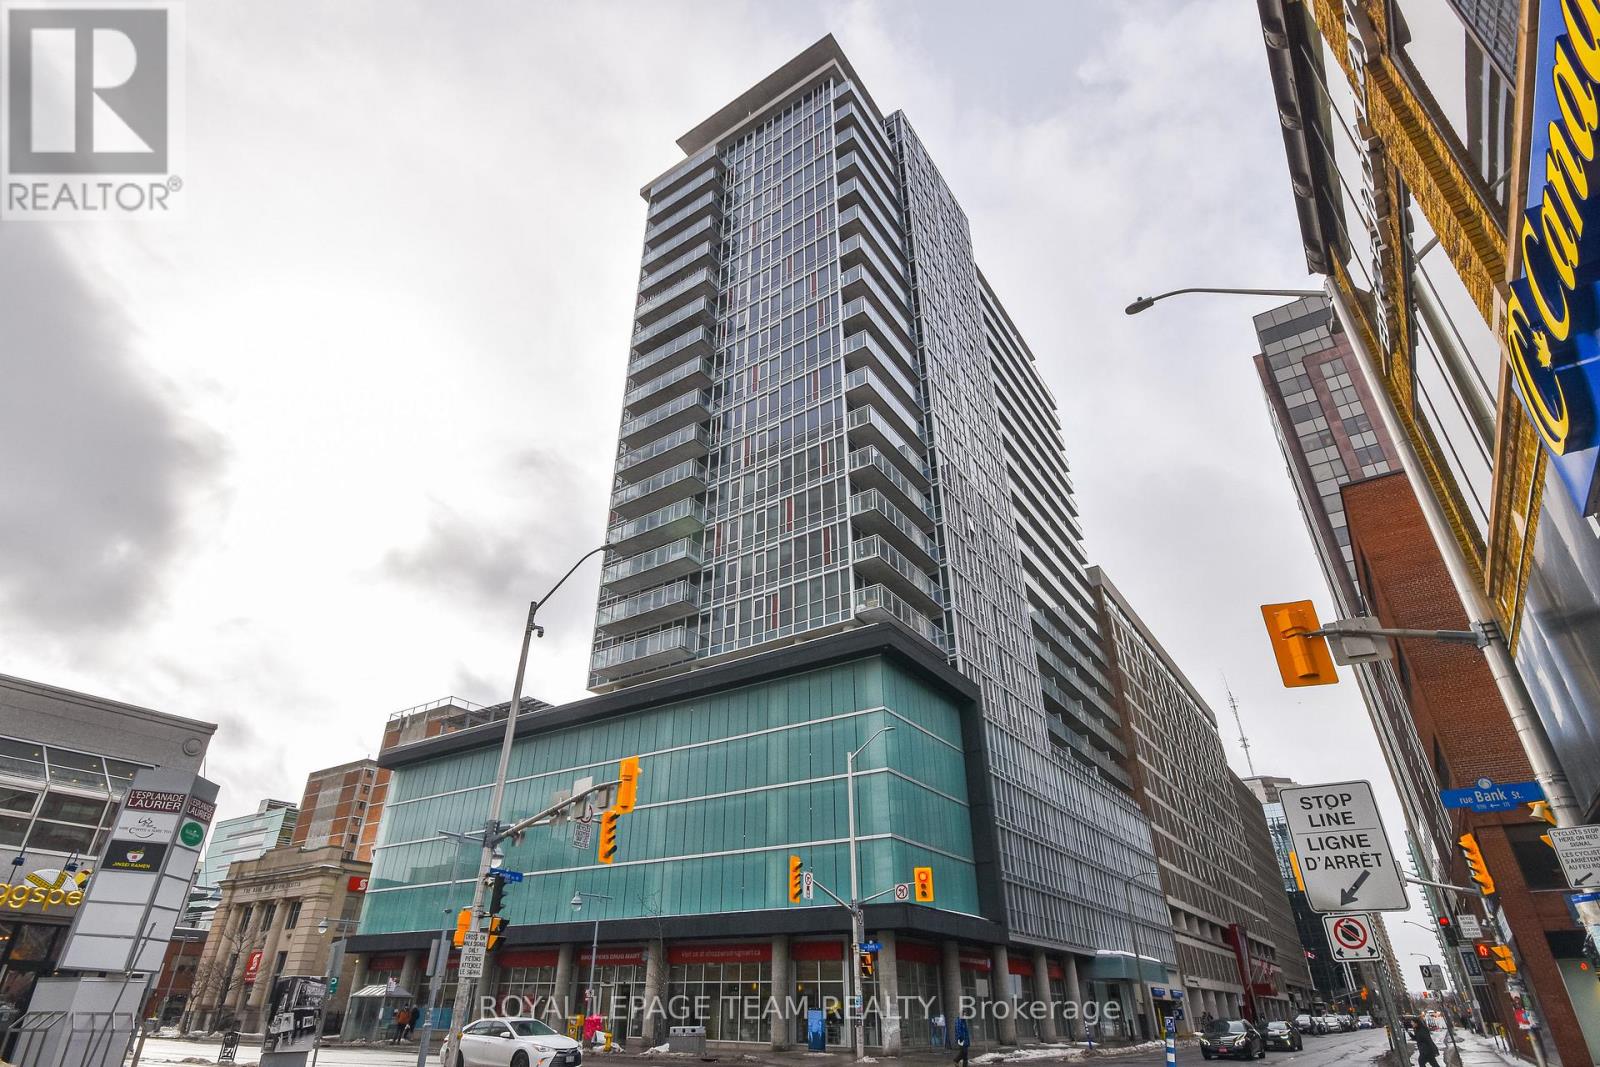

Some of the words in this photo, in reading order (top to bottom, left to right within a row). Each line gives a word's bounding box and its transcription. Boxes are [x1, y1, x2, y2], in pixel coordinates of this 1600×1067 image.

[130, 790, 184, 803] L'ESPLANADE
[1300, 793, 1352, 810] STOP
[1459, 796, 1473, 804] rue
[1474, 787, 1507, 802] Bank
[127, 798, 182, 811] LAURIER
[187, 805, 212, 821] LAURIER
[1308, 811, 1356, 828] LINE
[1553, 829, 1582, 837] CYCLISTS
[1583, 827, 1599, 835] STOP
[1306, 833, 1371, 851] LIGNE
[1304, 851, 1382, 871] D'ARRÊT
